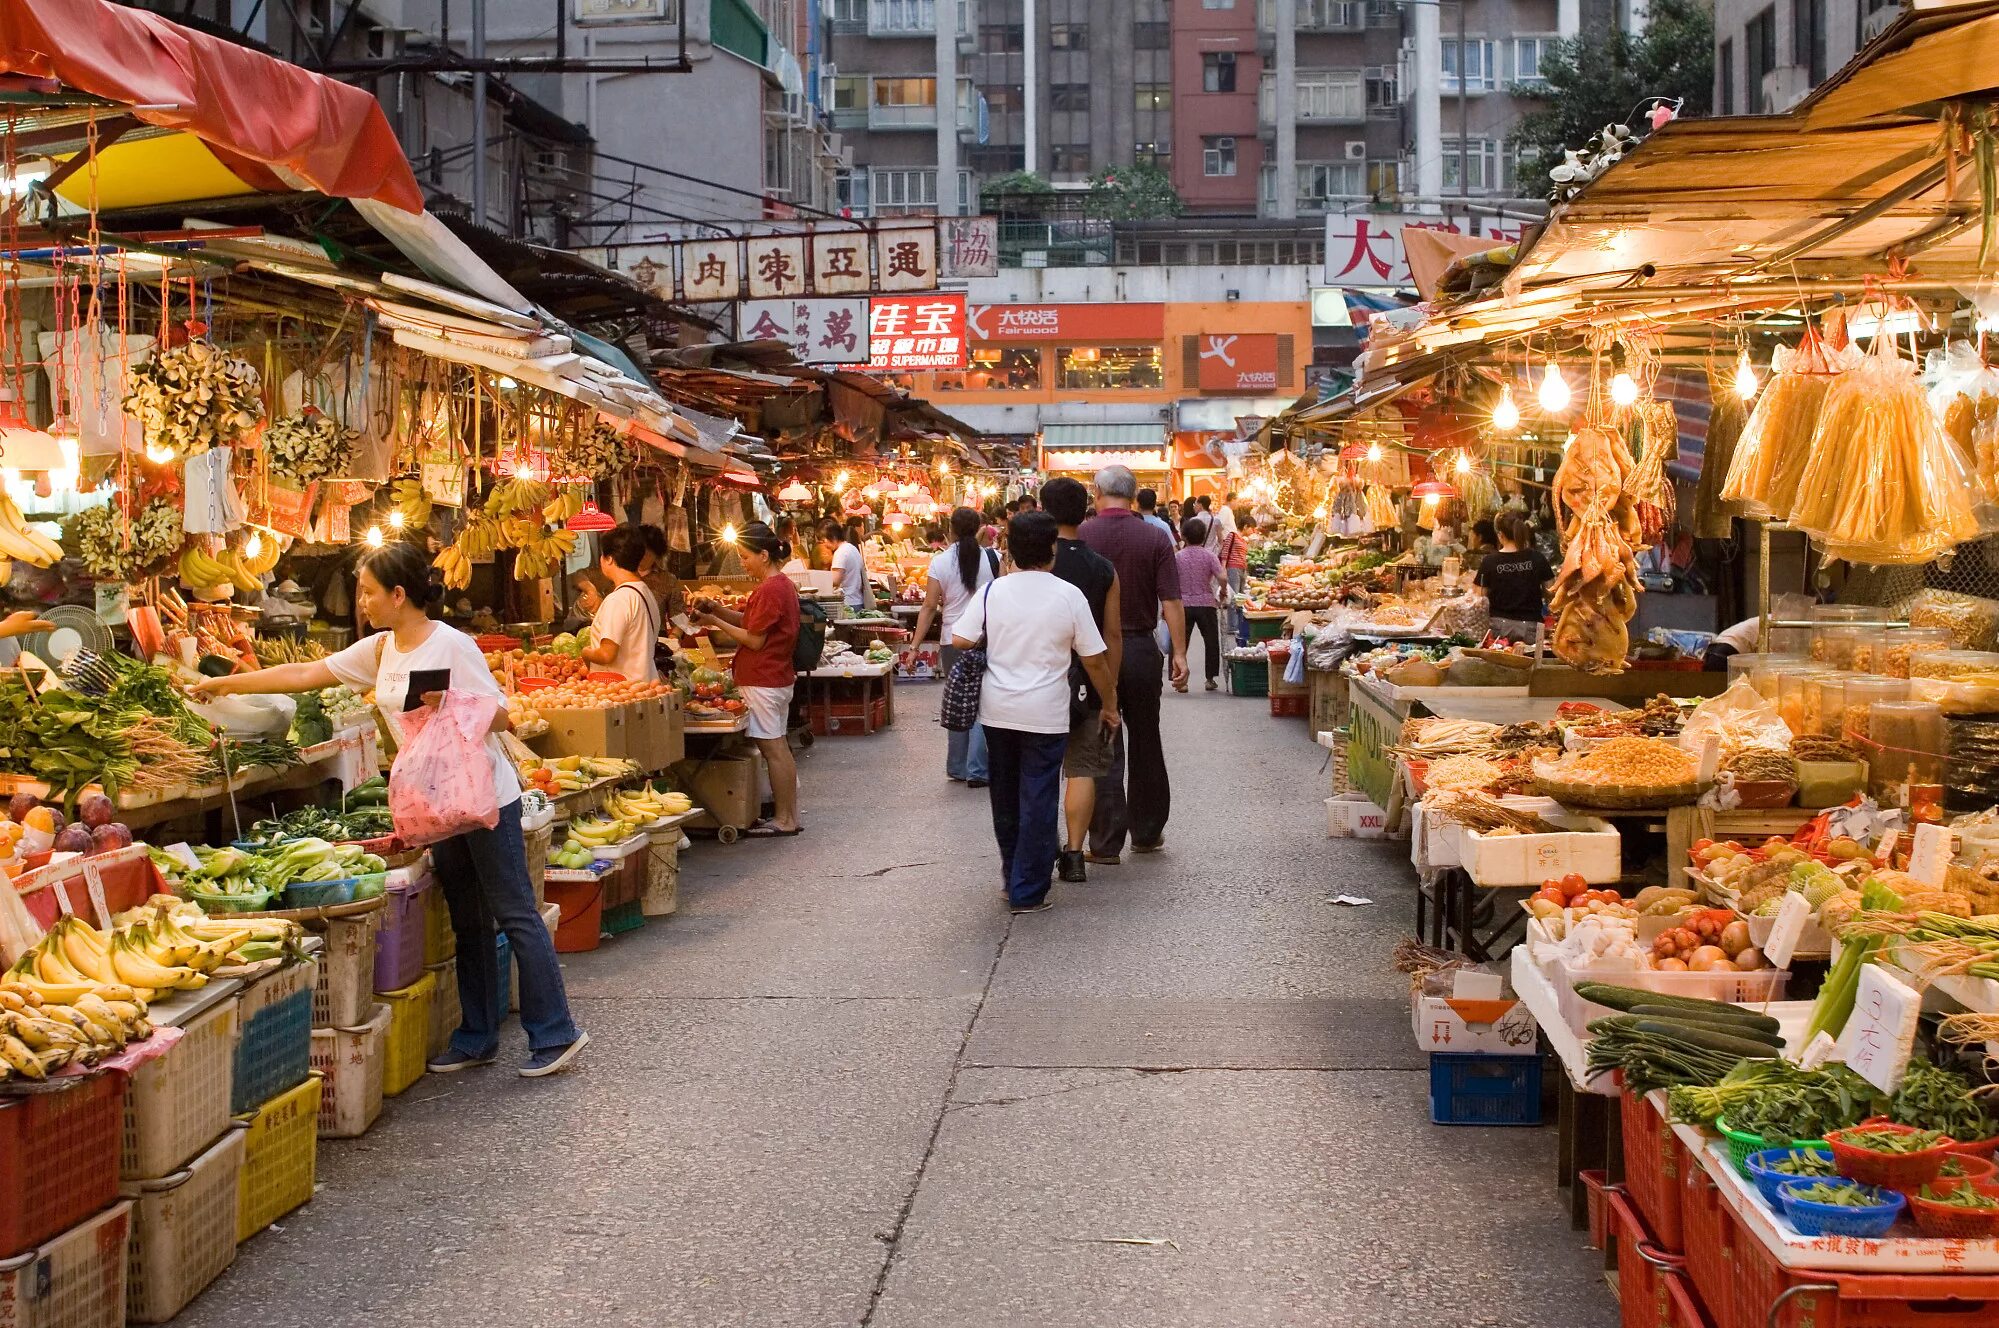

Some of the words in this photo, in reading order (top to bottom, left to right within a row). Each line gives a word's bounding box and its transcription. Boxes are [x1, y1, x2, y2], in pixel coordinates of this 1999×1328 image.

[998, 310, 1059, 326] 大快活
[998, 327, 1059, 336] Fairwood
[890, 354, 960, 367] SUPERMARKET
[1360, 816, 1382, 828] XXL
